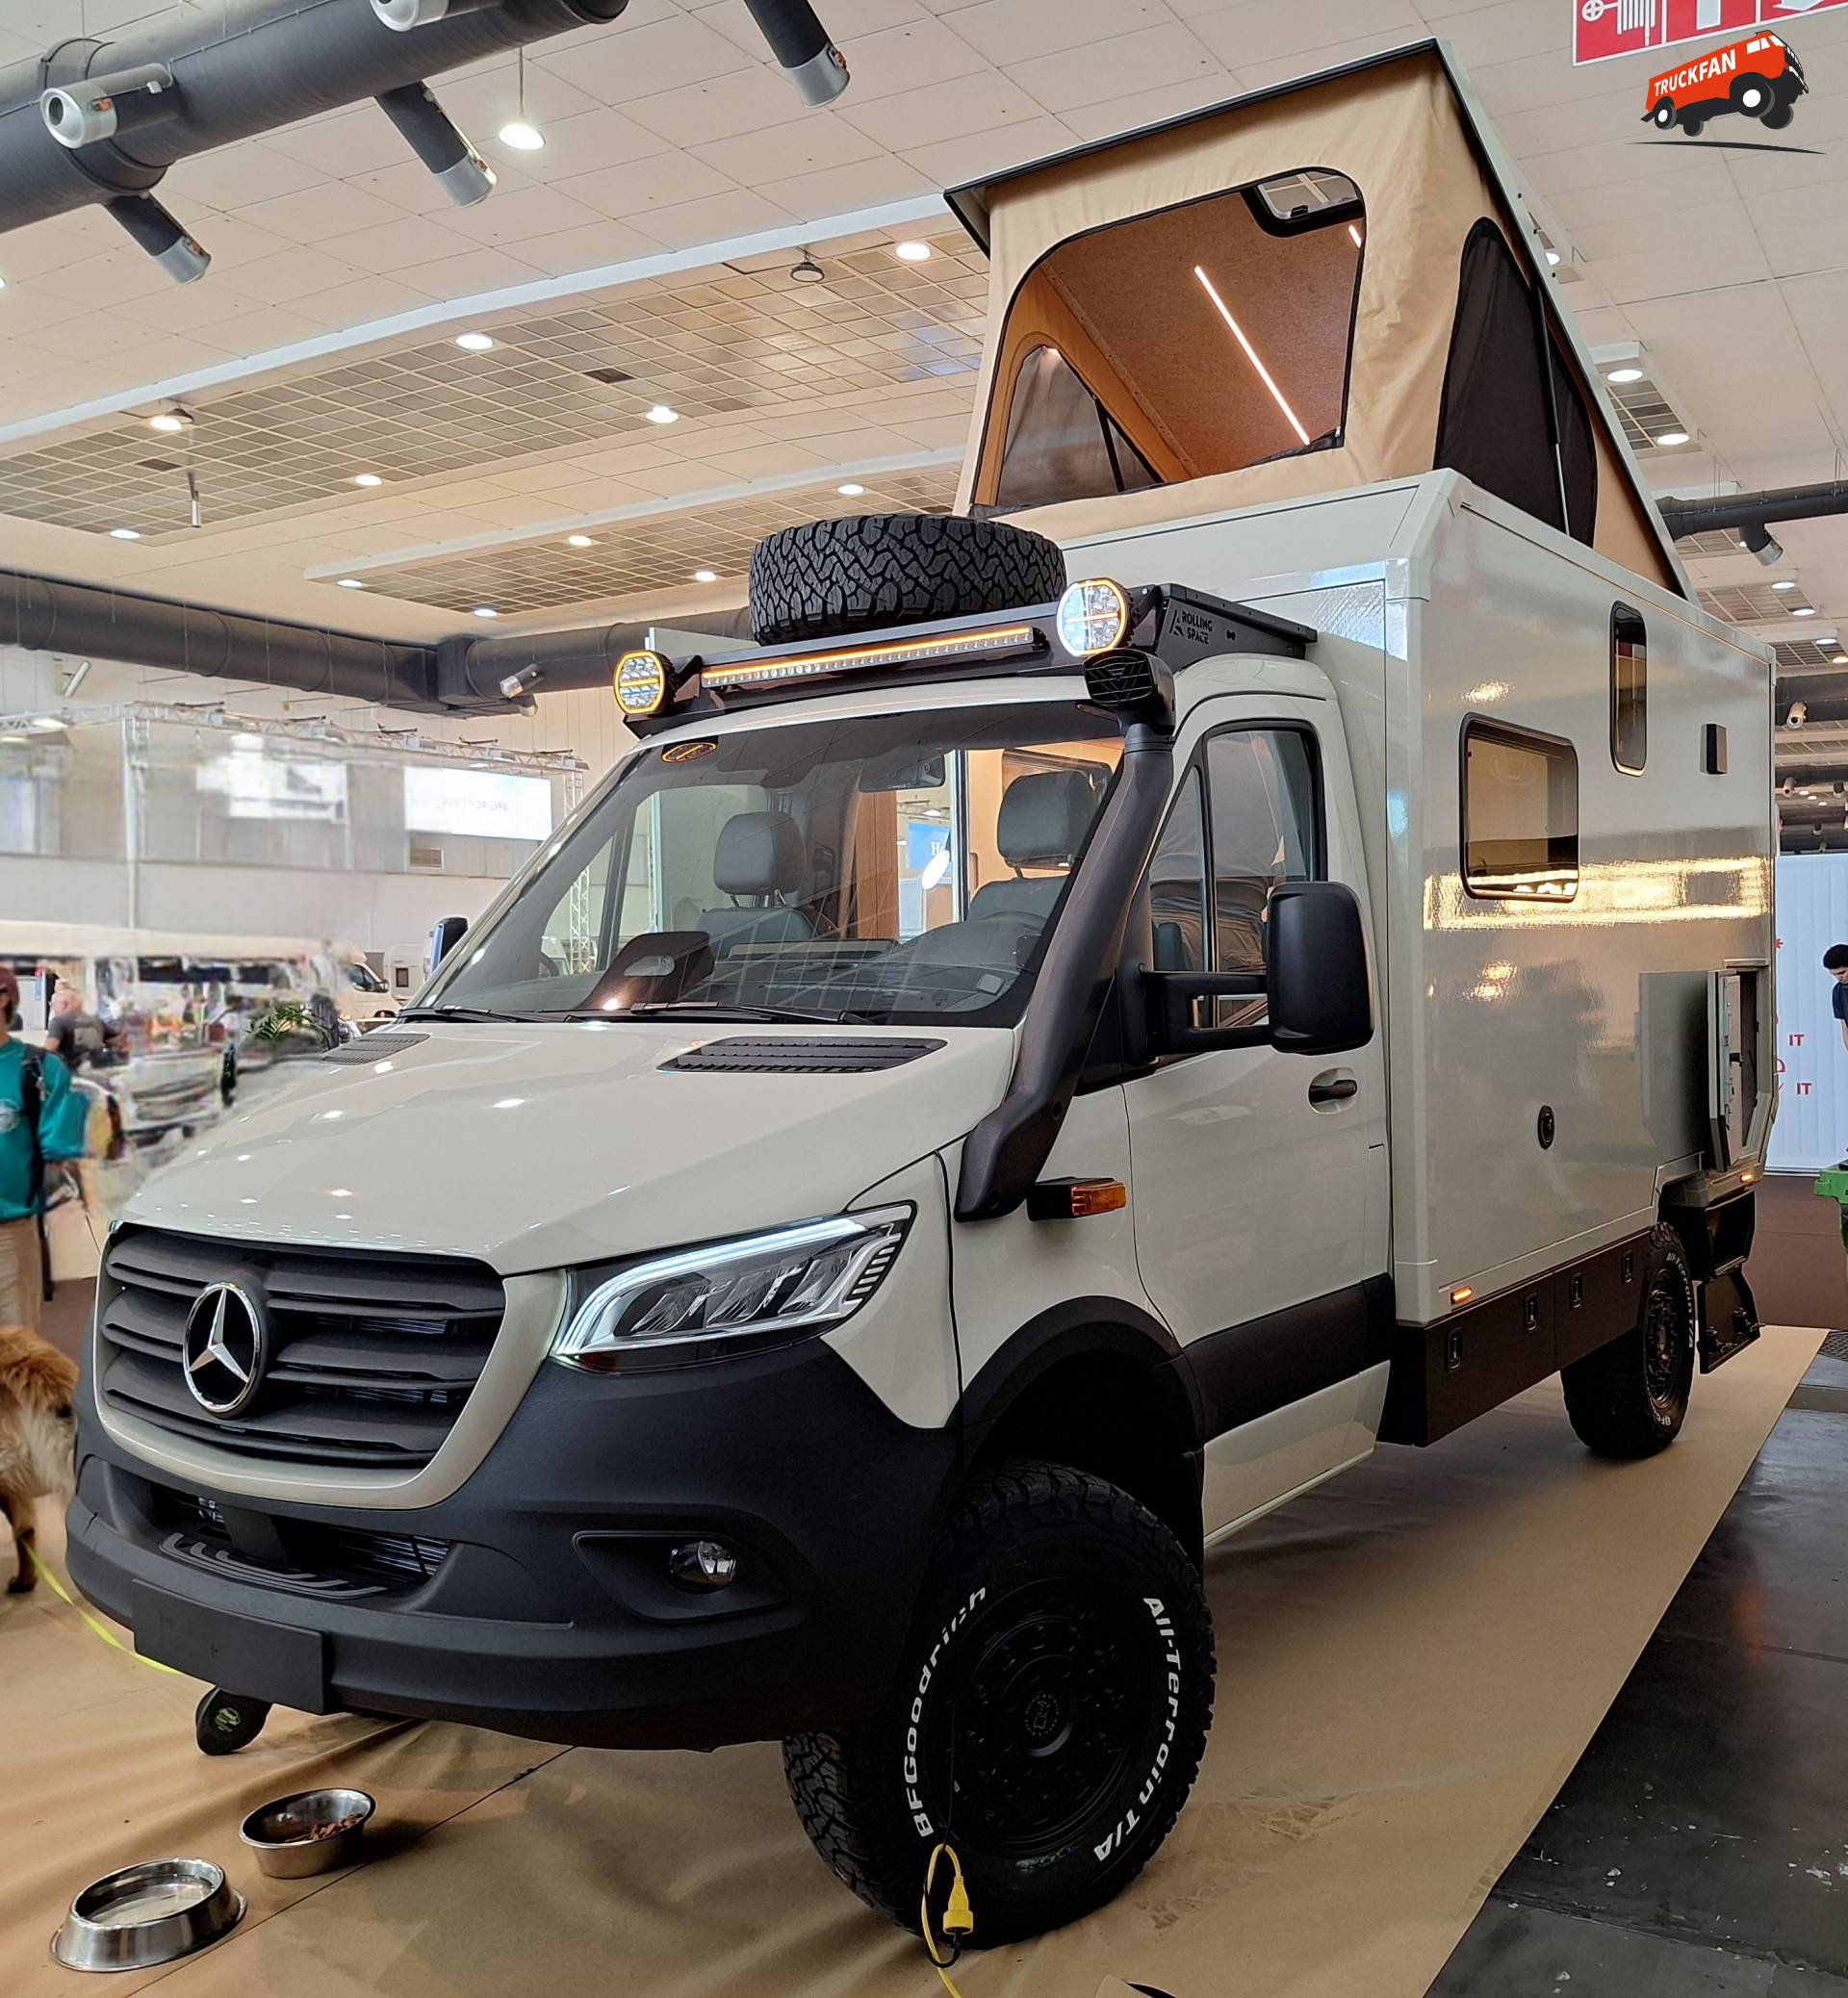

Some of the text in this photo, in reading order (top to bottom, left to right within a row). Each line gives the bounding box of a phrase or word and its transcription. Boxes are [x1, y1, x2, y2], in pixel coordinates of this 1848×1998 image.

[1182, 610, 1213, 631] ROLLING
[1187, 627, 1209, 645] SPACE
[1788, 1034, 1805, 1046] IT
[1796, 1082, 1812, 1095] IT
[904, 1587, 986, 1837] BFGoodrich
[1093, 1597, 1181, 1861] All-Terrain T/A
